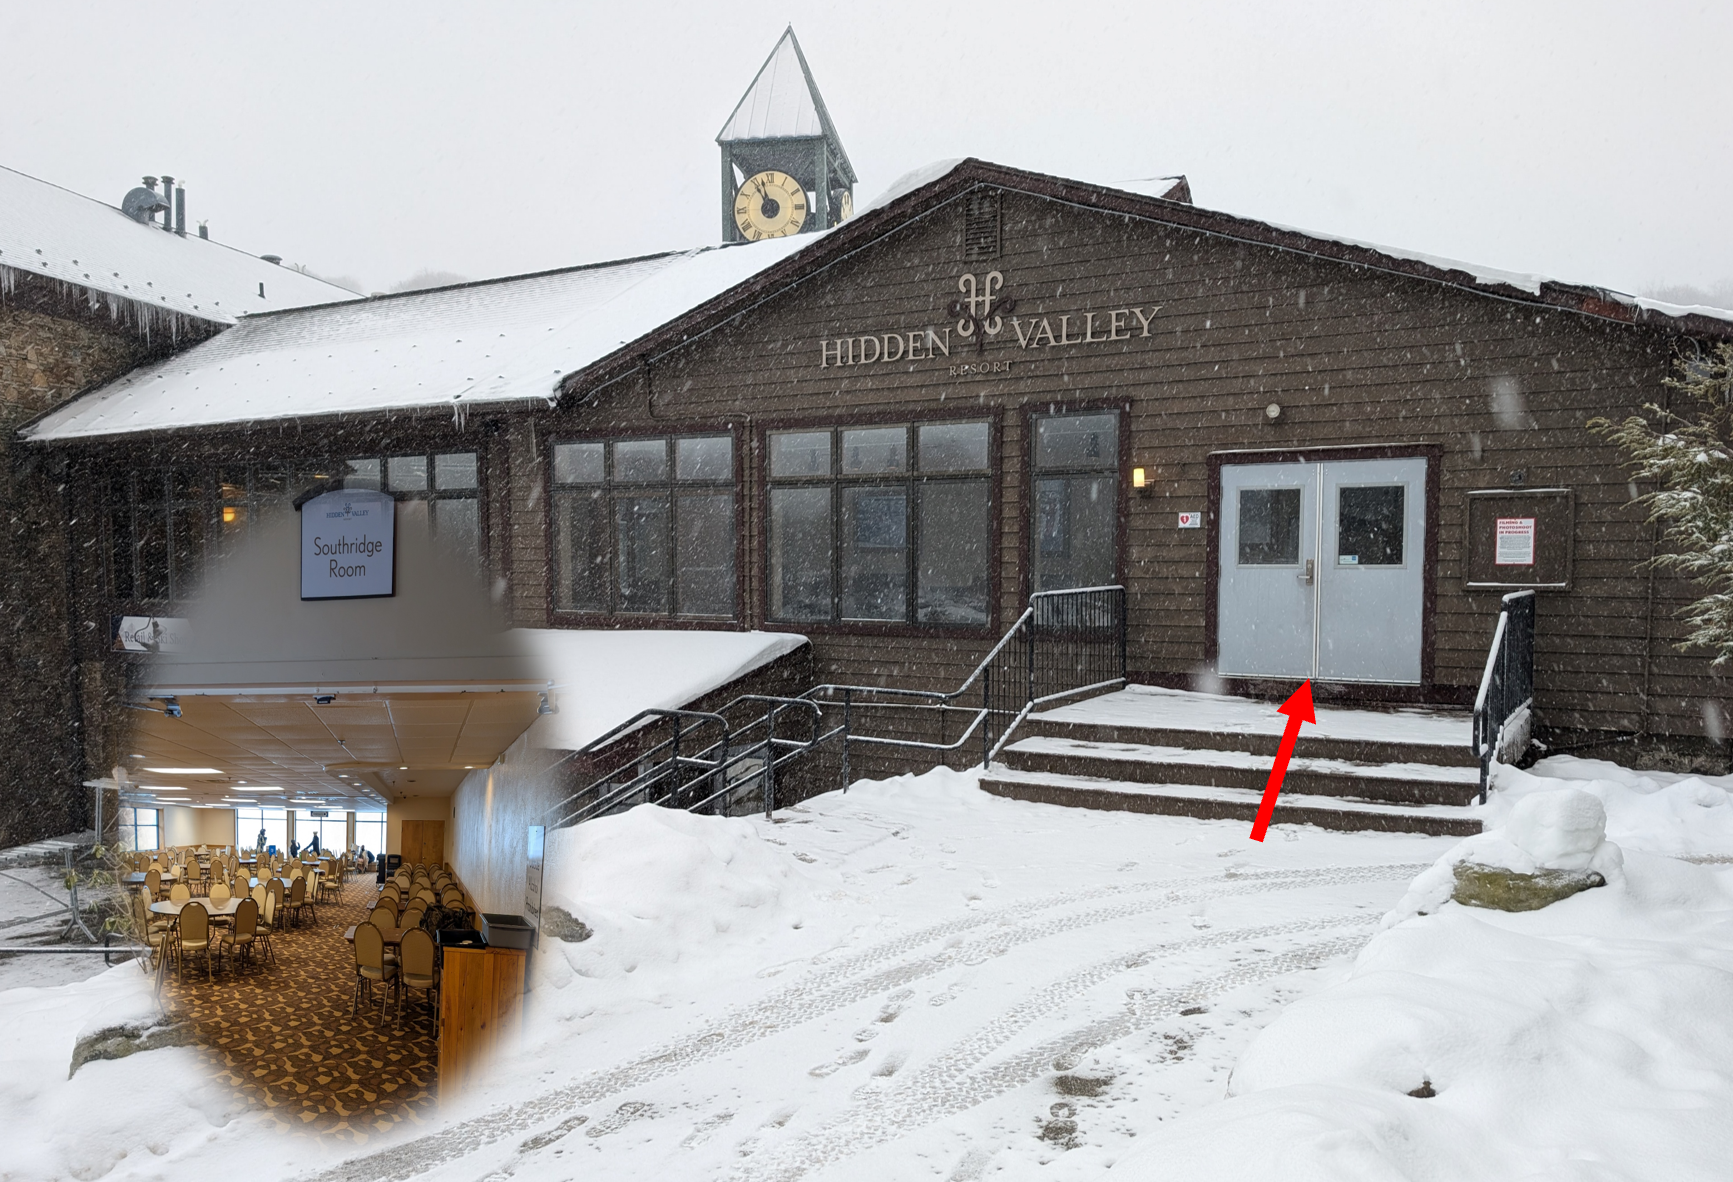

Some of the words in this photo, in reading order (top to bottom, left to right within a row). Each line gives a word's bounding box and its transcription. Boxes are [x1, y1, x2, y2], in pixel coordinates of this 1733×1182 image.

[740, 191, 750, 199] X
[819, 327, 952, 369] HIDDEN
[1010, 305, 1163, 350] VALLEY
[949, 360, 1013, 377] RESORT
[313, 534, 383, 557] Southridge
[329, 559, 366, 578] Room
[124, 631, 145, 643] Reail
[169, 632, 188, 647] Sho
